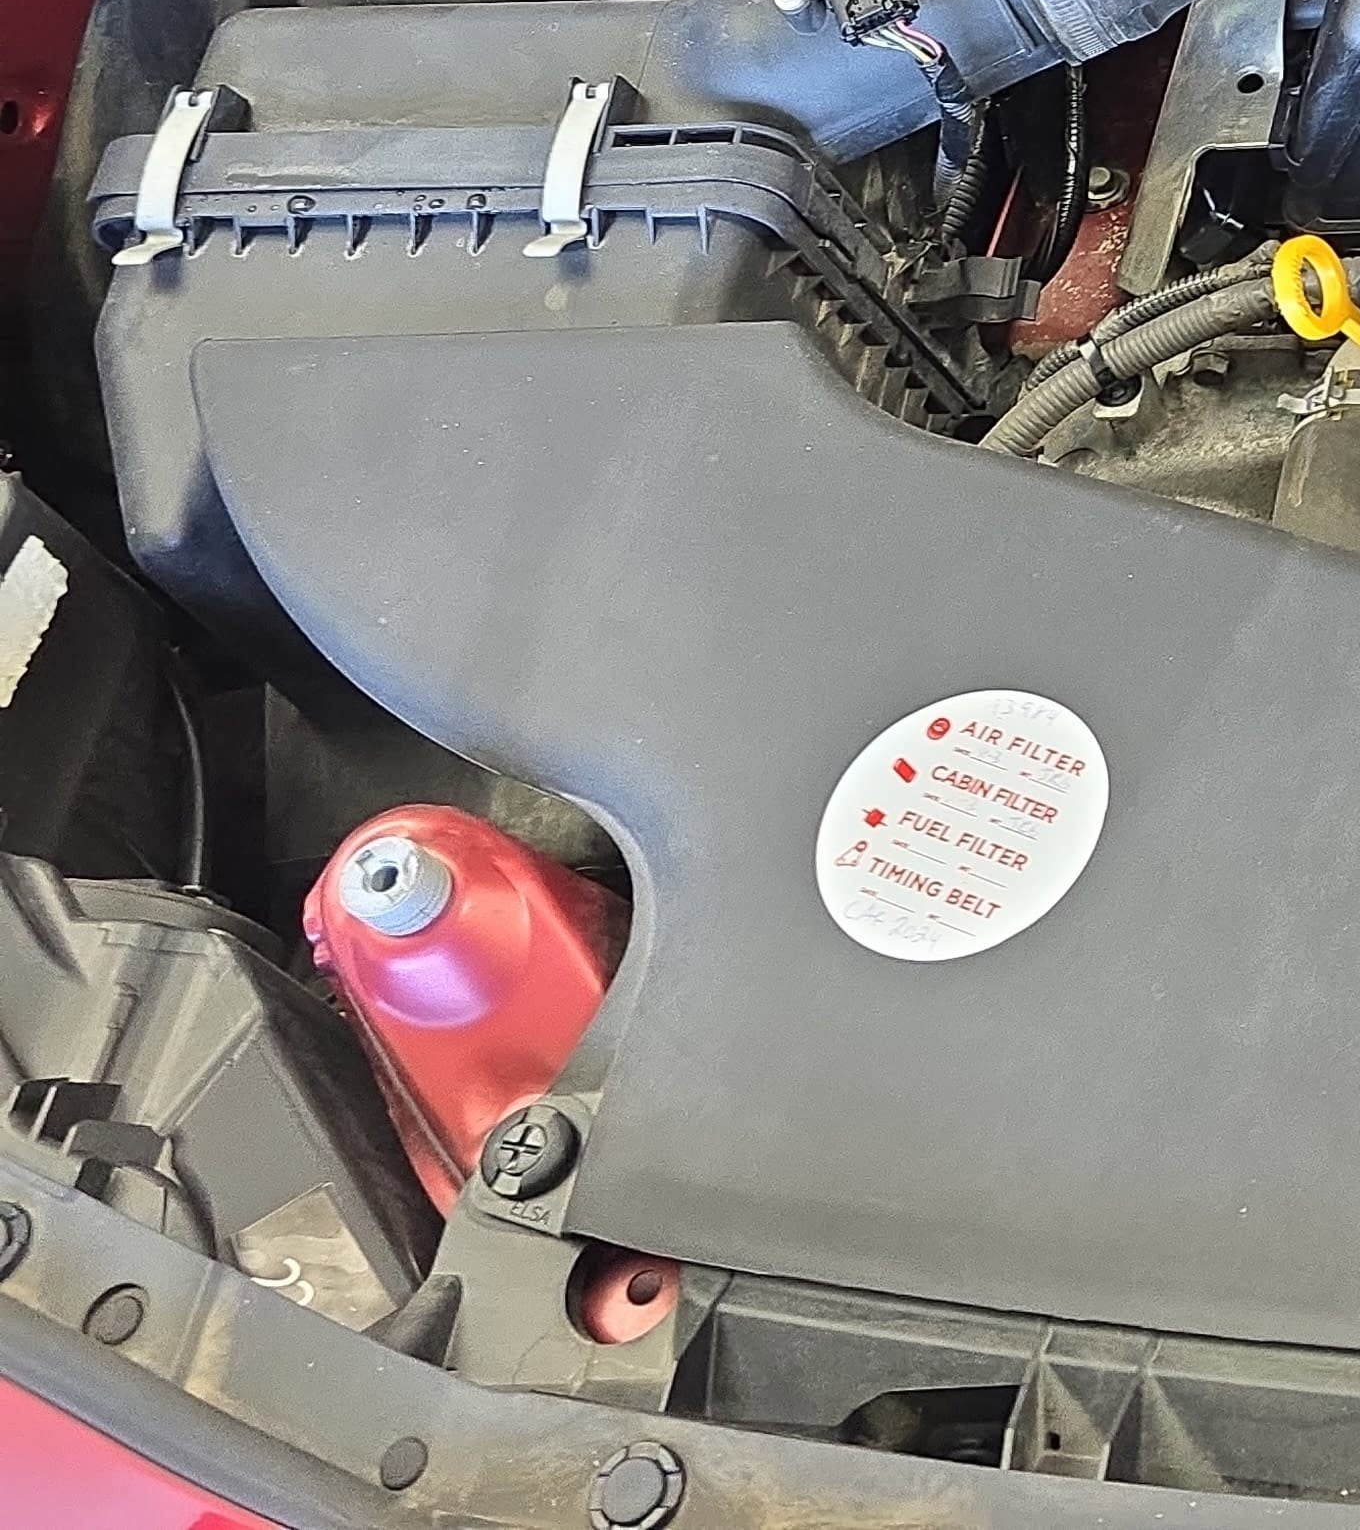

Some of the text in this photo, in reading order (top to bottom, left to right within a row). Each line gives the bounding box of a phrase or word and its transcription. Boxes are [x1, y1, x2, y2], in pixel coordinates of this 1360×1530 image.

[960, 721, 1003, 746] AIR
[1007, 736, 1087, 777] FILTER
[931, 765, 992, 803] CABIN
[994, 787, 1059, 824] FILTER
[899, 811, 951, 844] FUEL
[955, 832, 1029, 872] FILTER
[868, 856, 1002, 919] TIMING BELT
